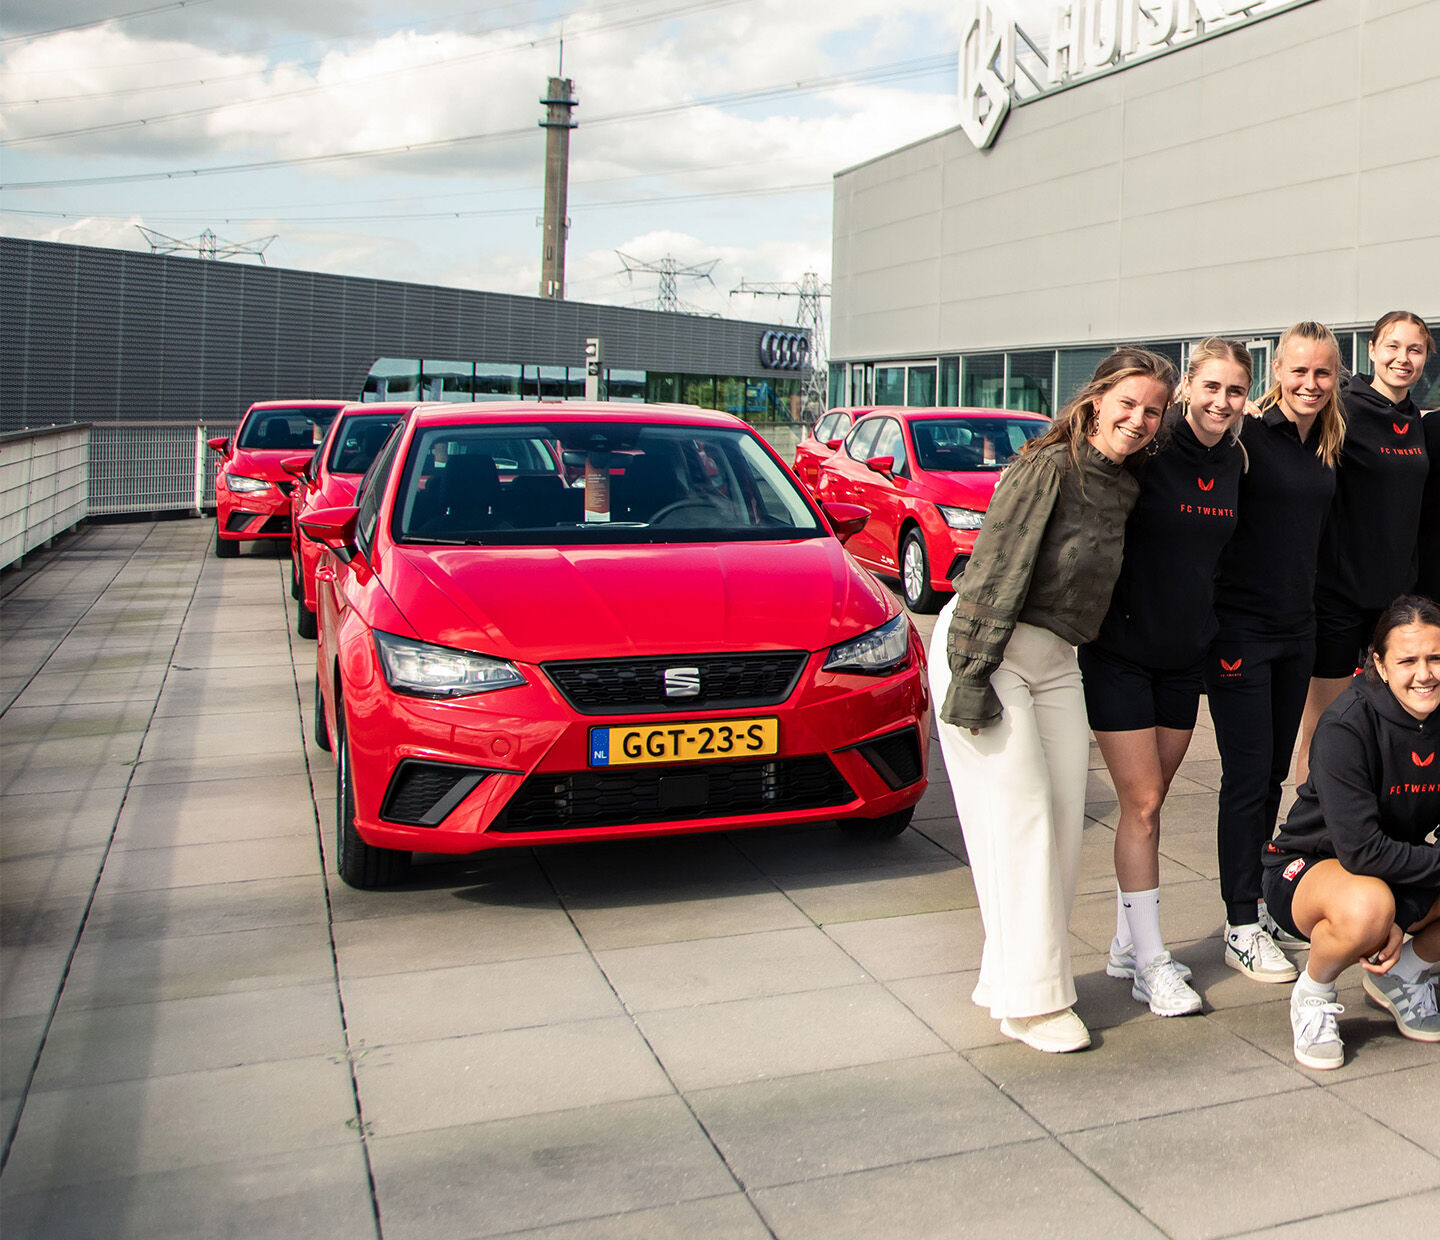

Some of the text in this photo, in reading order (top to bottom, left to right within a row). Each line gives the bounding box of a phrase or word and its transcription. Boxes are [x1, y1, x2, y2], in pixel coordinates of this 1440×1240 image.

[1180, 504, 1235, 518] FC TWENTE
[593, 724, 764, 760] NL GGT-23-S
